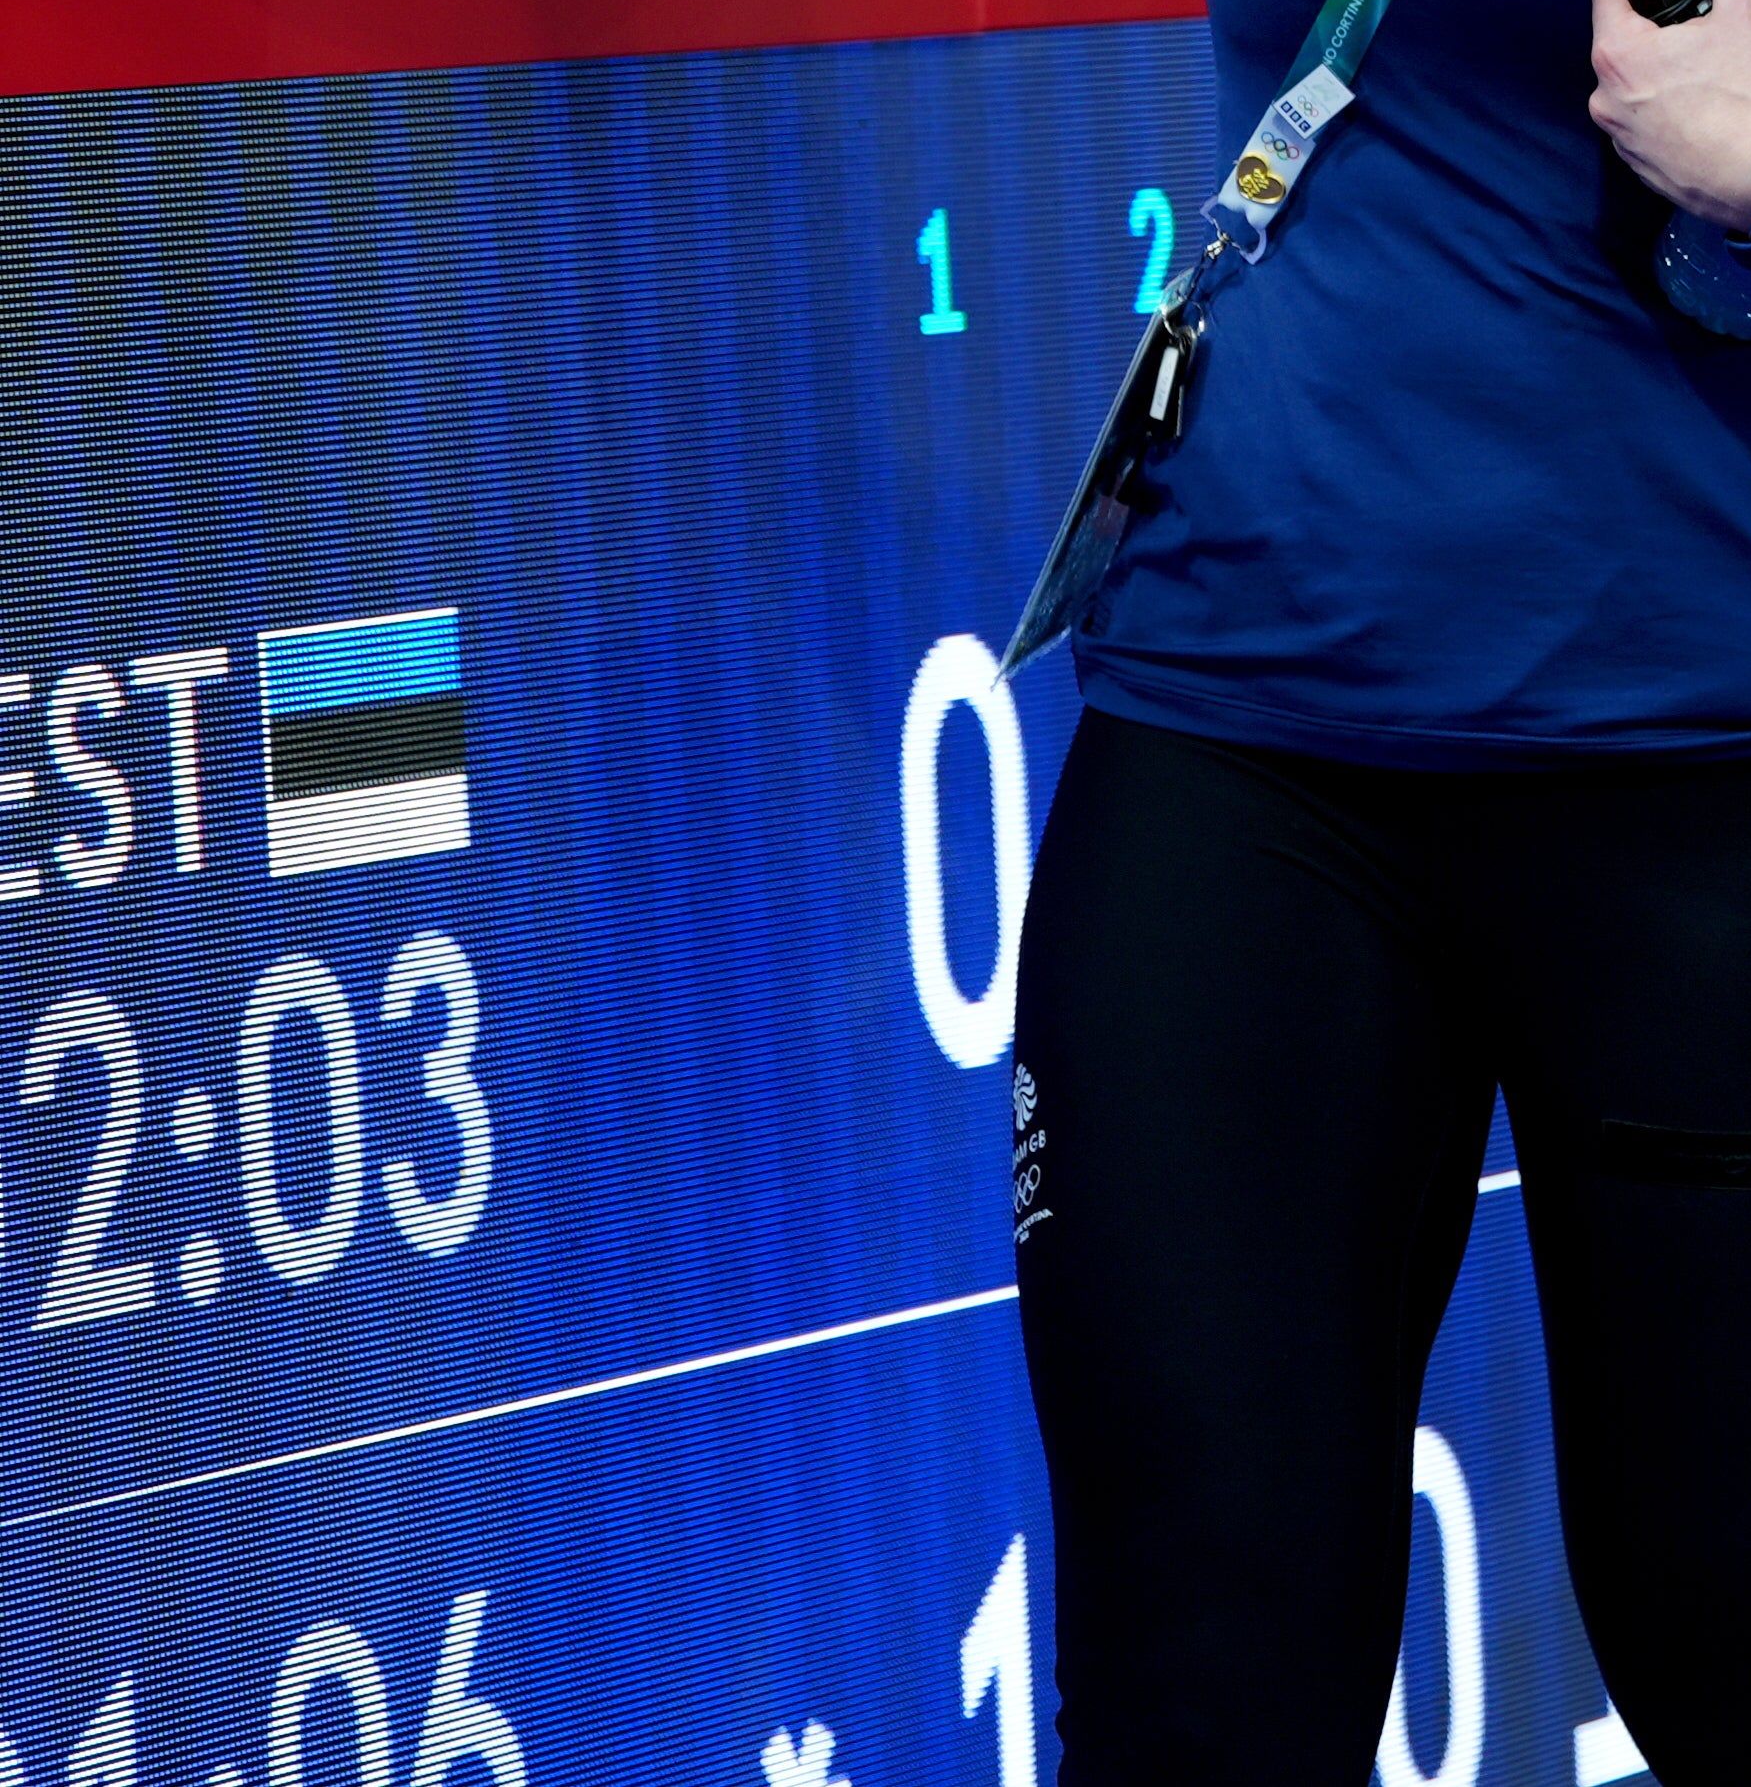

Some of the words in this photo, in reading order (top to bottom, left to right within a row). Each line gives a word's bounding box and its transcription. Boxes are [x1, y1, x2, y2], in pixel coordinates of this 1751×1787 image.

[917, 209, 967, 335] 1
[1128, 188, 1175, 312] 2
[900, 633, 1031, 1068] 0
[18, 929, 493, 1330] 2:03
[1029, 1129, 1047, 1153] GB
